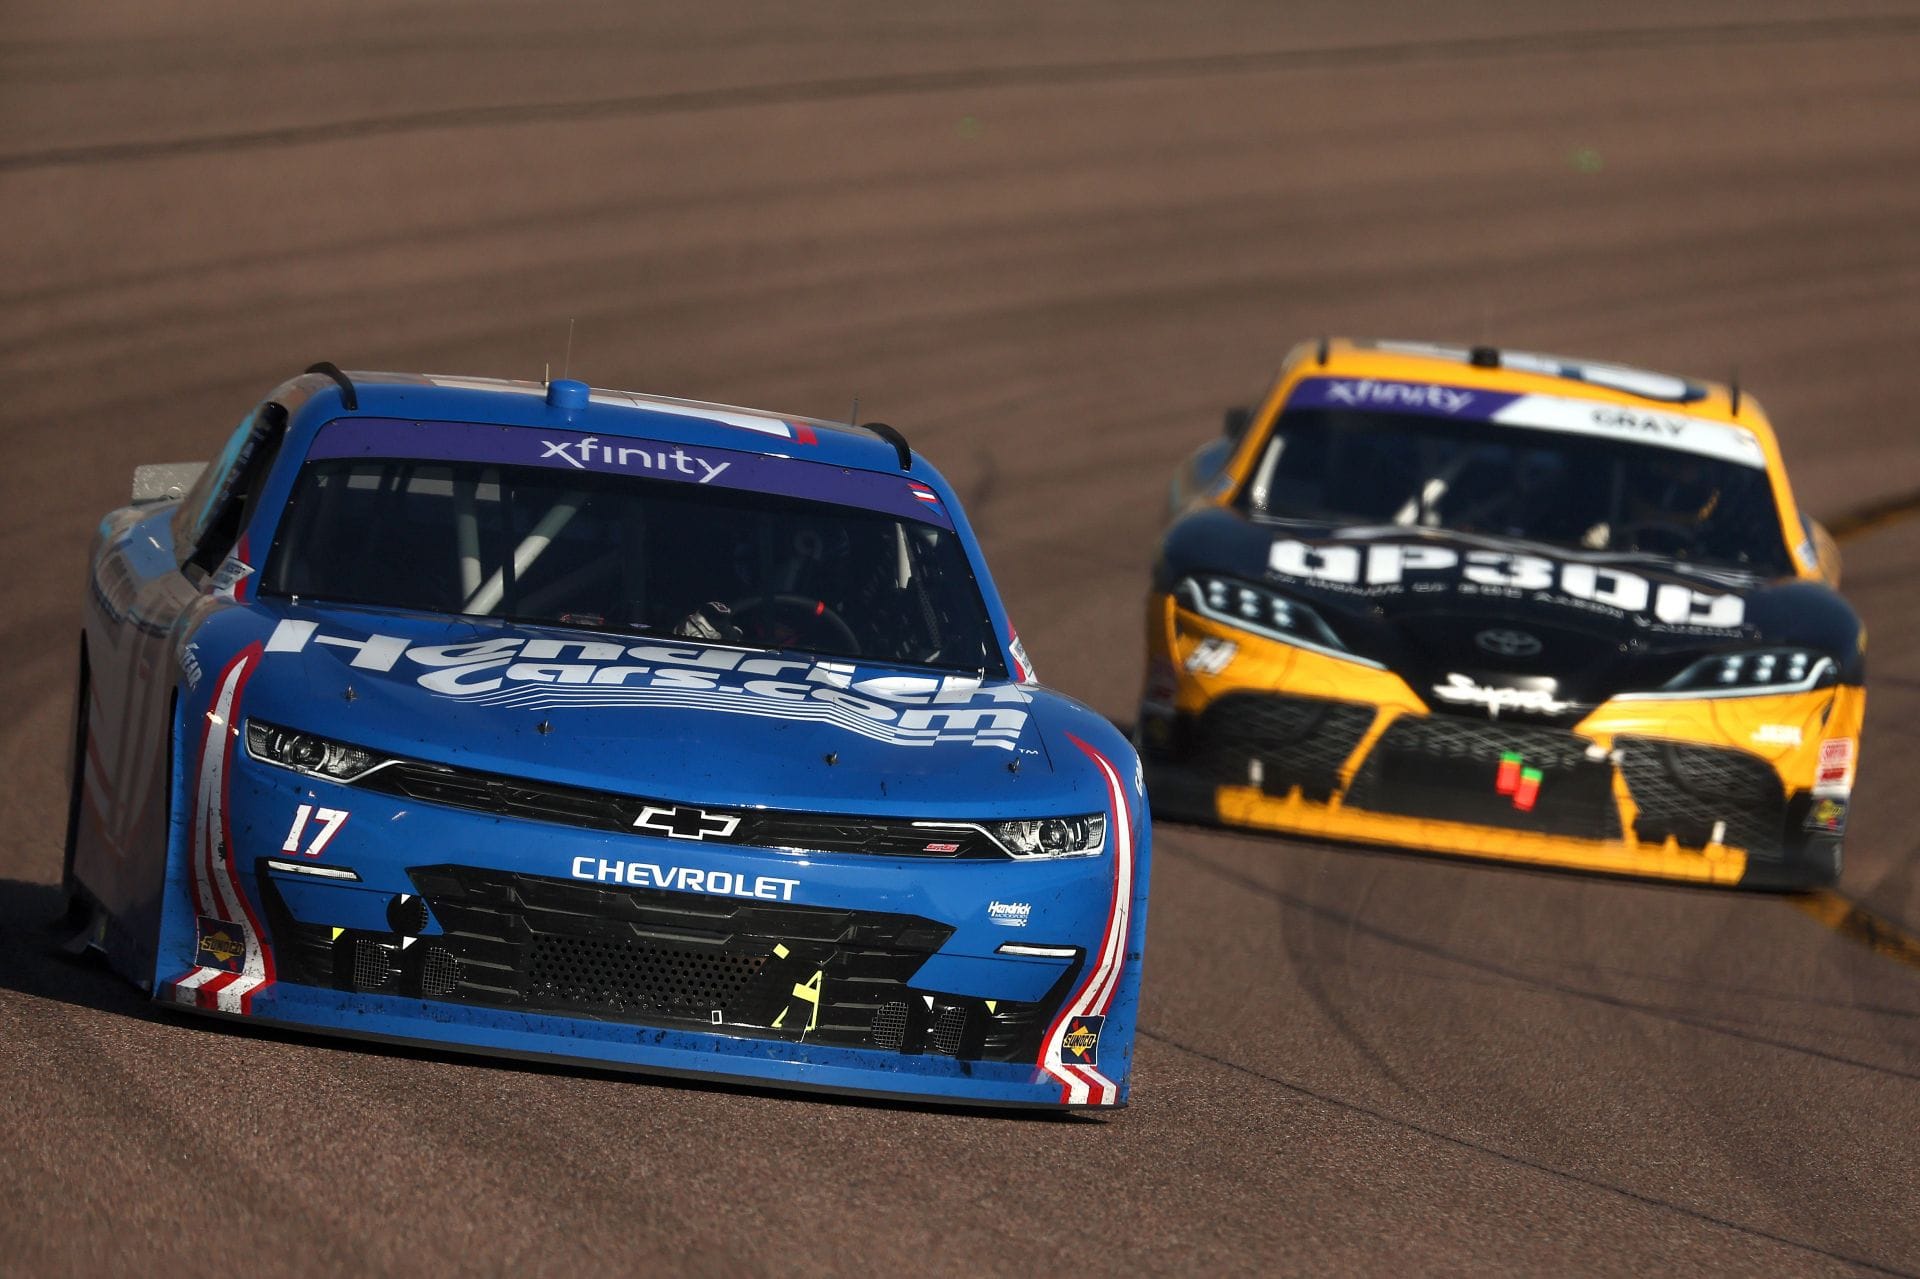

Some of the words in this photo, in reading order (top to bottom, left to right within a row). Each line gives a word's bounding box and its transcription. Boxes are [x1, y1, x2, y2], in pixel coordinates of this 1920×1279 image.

[1327, 379, 1474, 413] xfinity
[1592, 408, 1689, 437] GRAY
[540, 437, 732, 483] xfinity
[264, 618, 1034, 704] Hendrick
[281, 803, 352, 858] 17
[572, 856, 801, 901] CHEVROLET
[987, 900, 1032, 917] Hendrick
[201, 937, 245, 955] SUNOCO
[1063, 1033, 1097, 1049] SUNOCO
